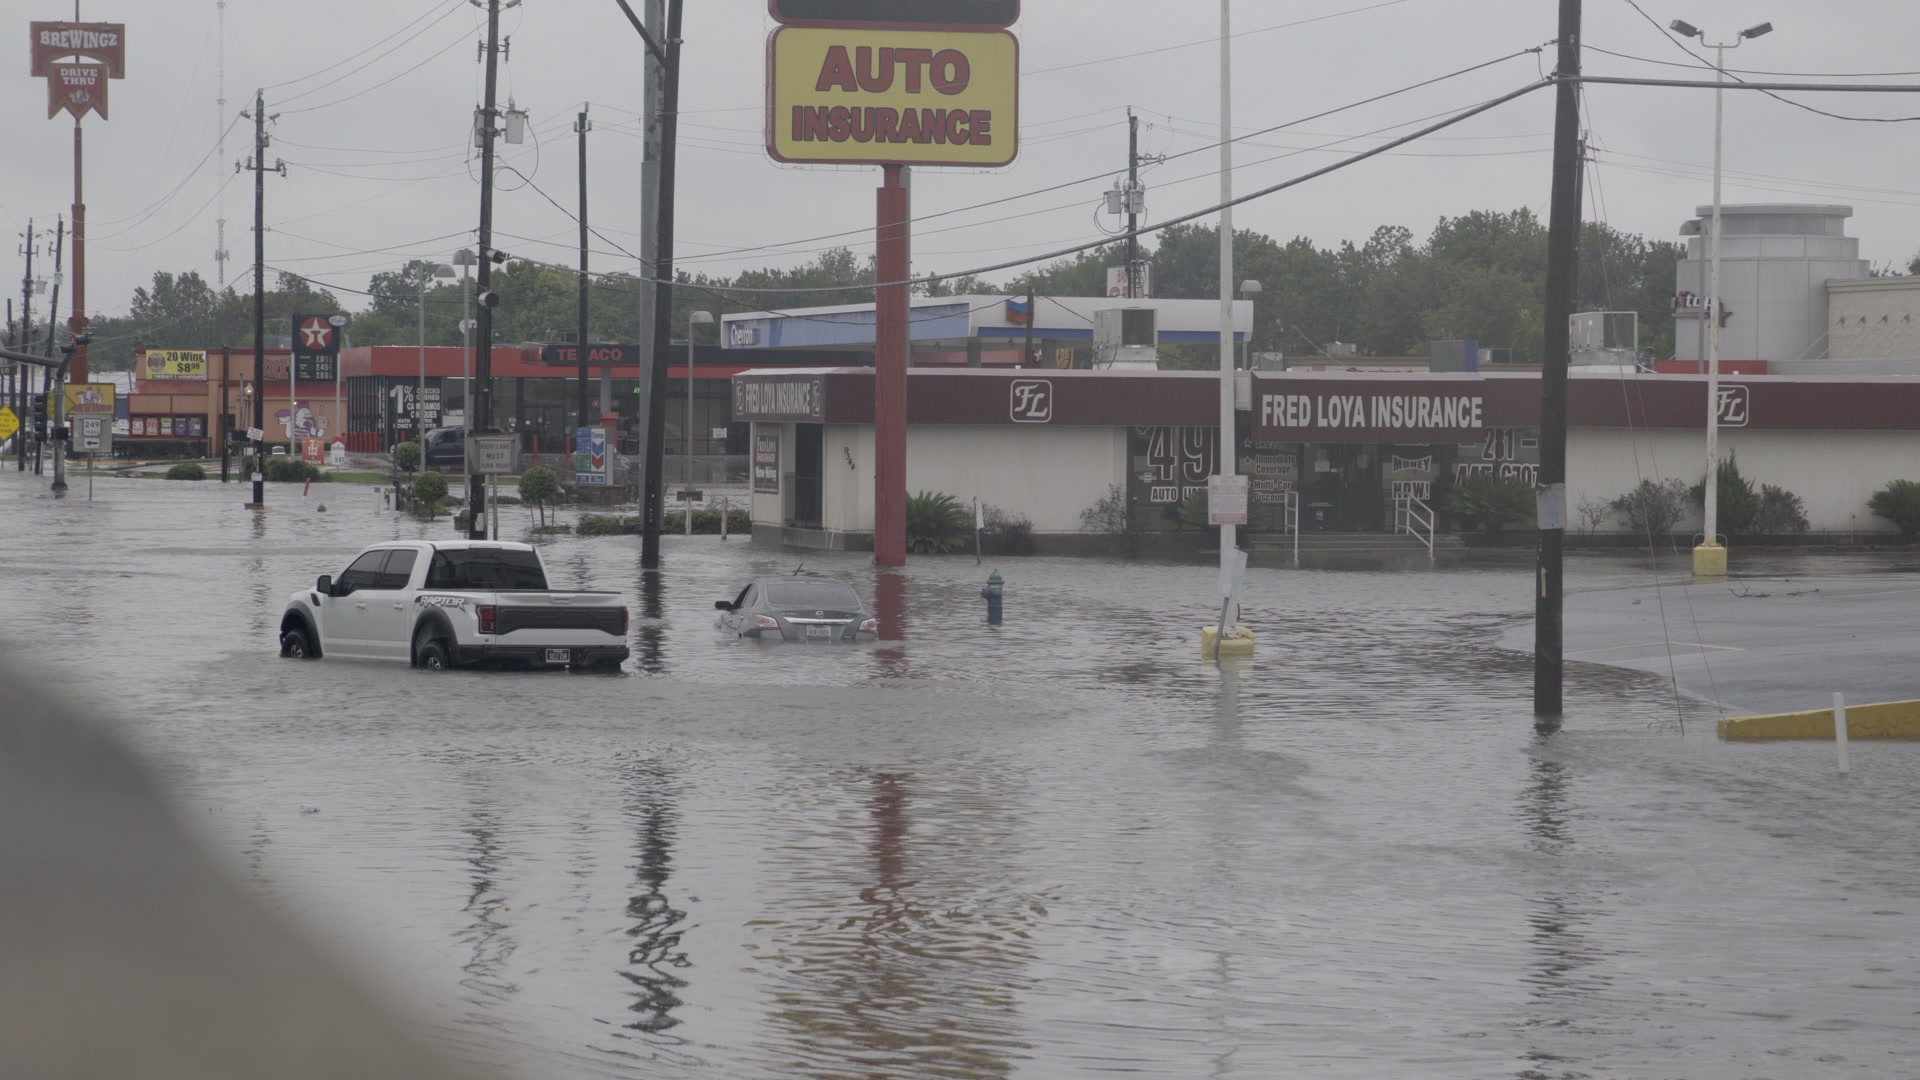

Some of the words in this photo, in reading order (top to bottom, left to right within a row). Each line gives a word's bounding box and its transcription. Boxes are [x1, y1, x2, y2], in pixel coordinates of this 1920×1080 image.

[40, 30, 118, 48] BREWINGZ
[60, 69, 98, 77] DRIVE
[815, 45, 970, 95] AUTO
[62, 77, 96, 85] THRU
[791, 105, 992, 145] INSURANCE
[730, 324, 754, 345] Chevron
[166, 351, 178, 362] 20
[556, 348, 623, 361] TEACO
[390, 385, 414, 413] 1%
[745, 383, 760, 413] FRED
[761, 383, 776, 414] LOYA
[776, 382, 811, 414] INSURANCE
[406, 402, 441, 411] CAMIAMOS
[1262, 394, 1312, 427] FRED
[1317, 394, 1366, 428] LOYA
[1371, 395, 1483, 429] INSURANCE
[1481, 428, 1515, 461] 281
[1255, 453, 1297, 464] Immediate
[1392, 455, 1432, 473] MONEY
[755, 466, 765, 478] Now
[764, 465, 777, 482] Hiring
[1255, 464, 1292, 475] Coverage
[1253, 480, 1292, 490] Multi-Car
[1392, 481, 1430, 500] NOW!
[1150, 486, 1178, 502] AUTO
[1253, 491, 1286, 502] Discoun
[420, 596, 465, 612] RAPTOR
